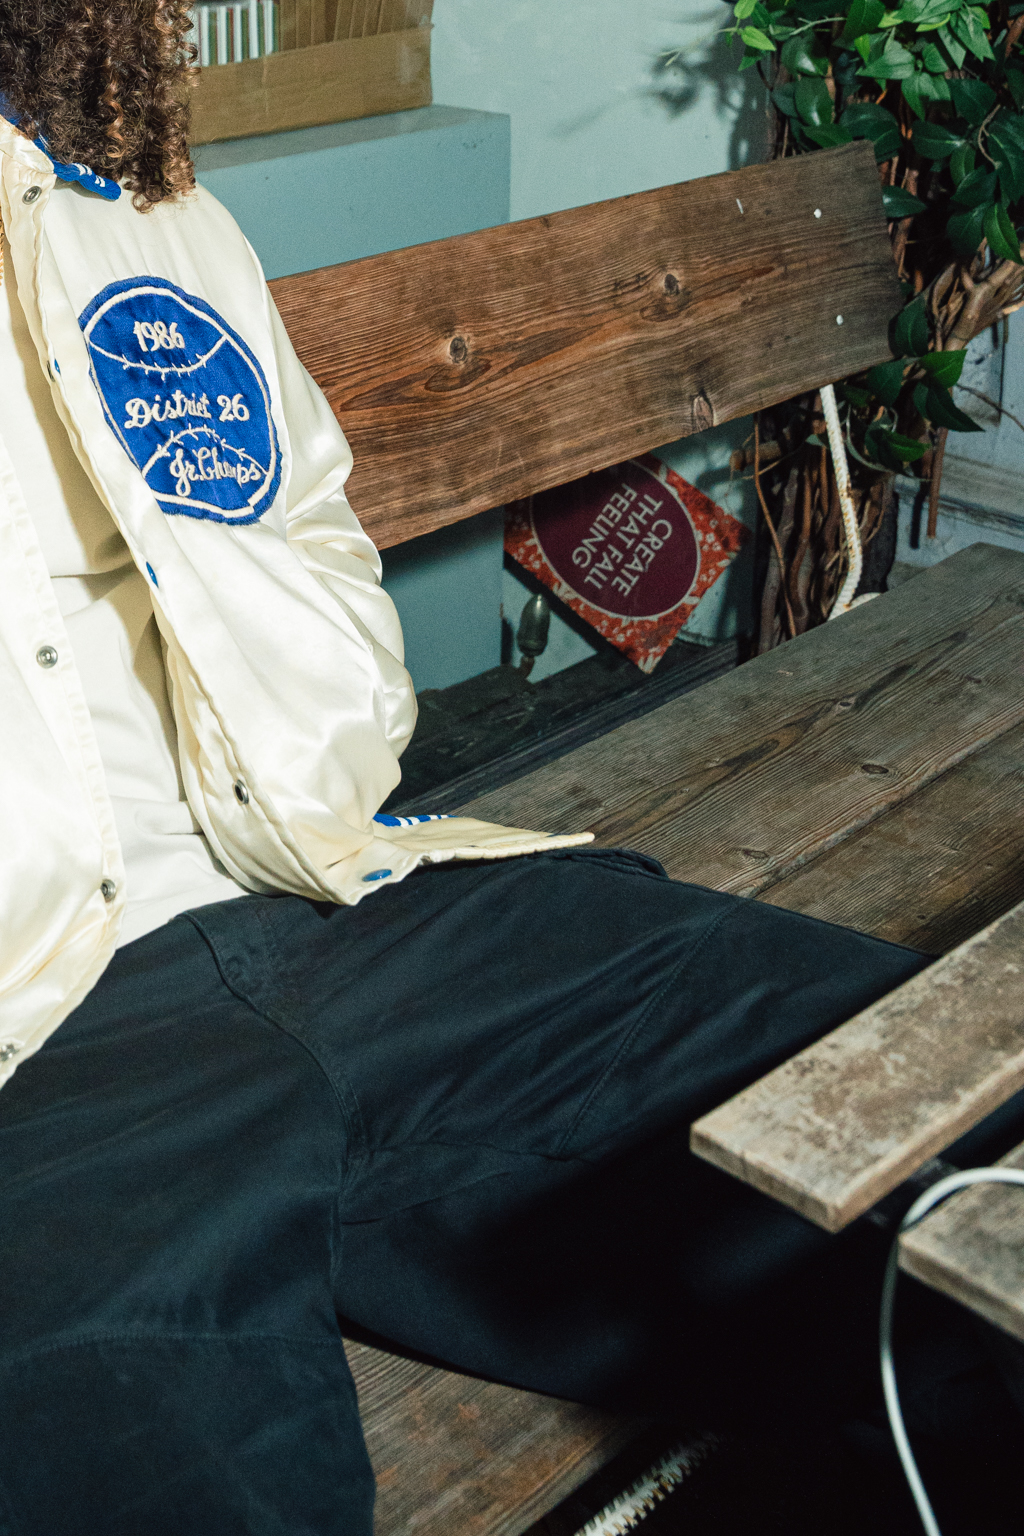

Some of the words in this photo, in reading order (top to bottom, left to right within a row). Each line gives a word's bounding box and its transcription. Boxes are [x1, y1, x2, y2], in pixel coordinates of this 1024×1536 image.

[133, 320, 186, 353] 1986
[123, 388, 213, 430] District
[216, 392, 251, 423] 26
[571, 482, 639, 569] FEELING
[616, 493, 664, 550] THAT
[583, 543, 625, 590] FALL
[610, 518, 673, 597] CREATE
